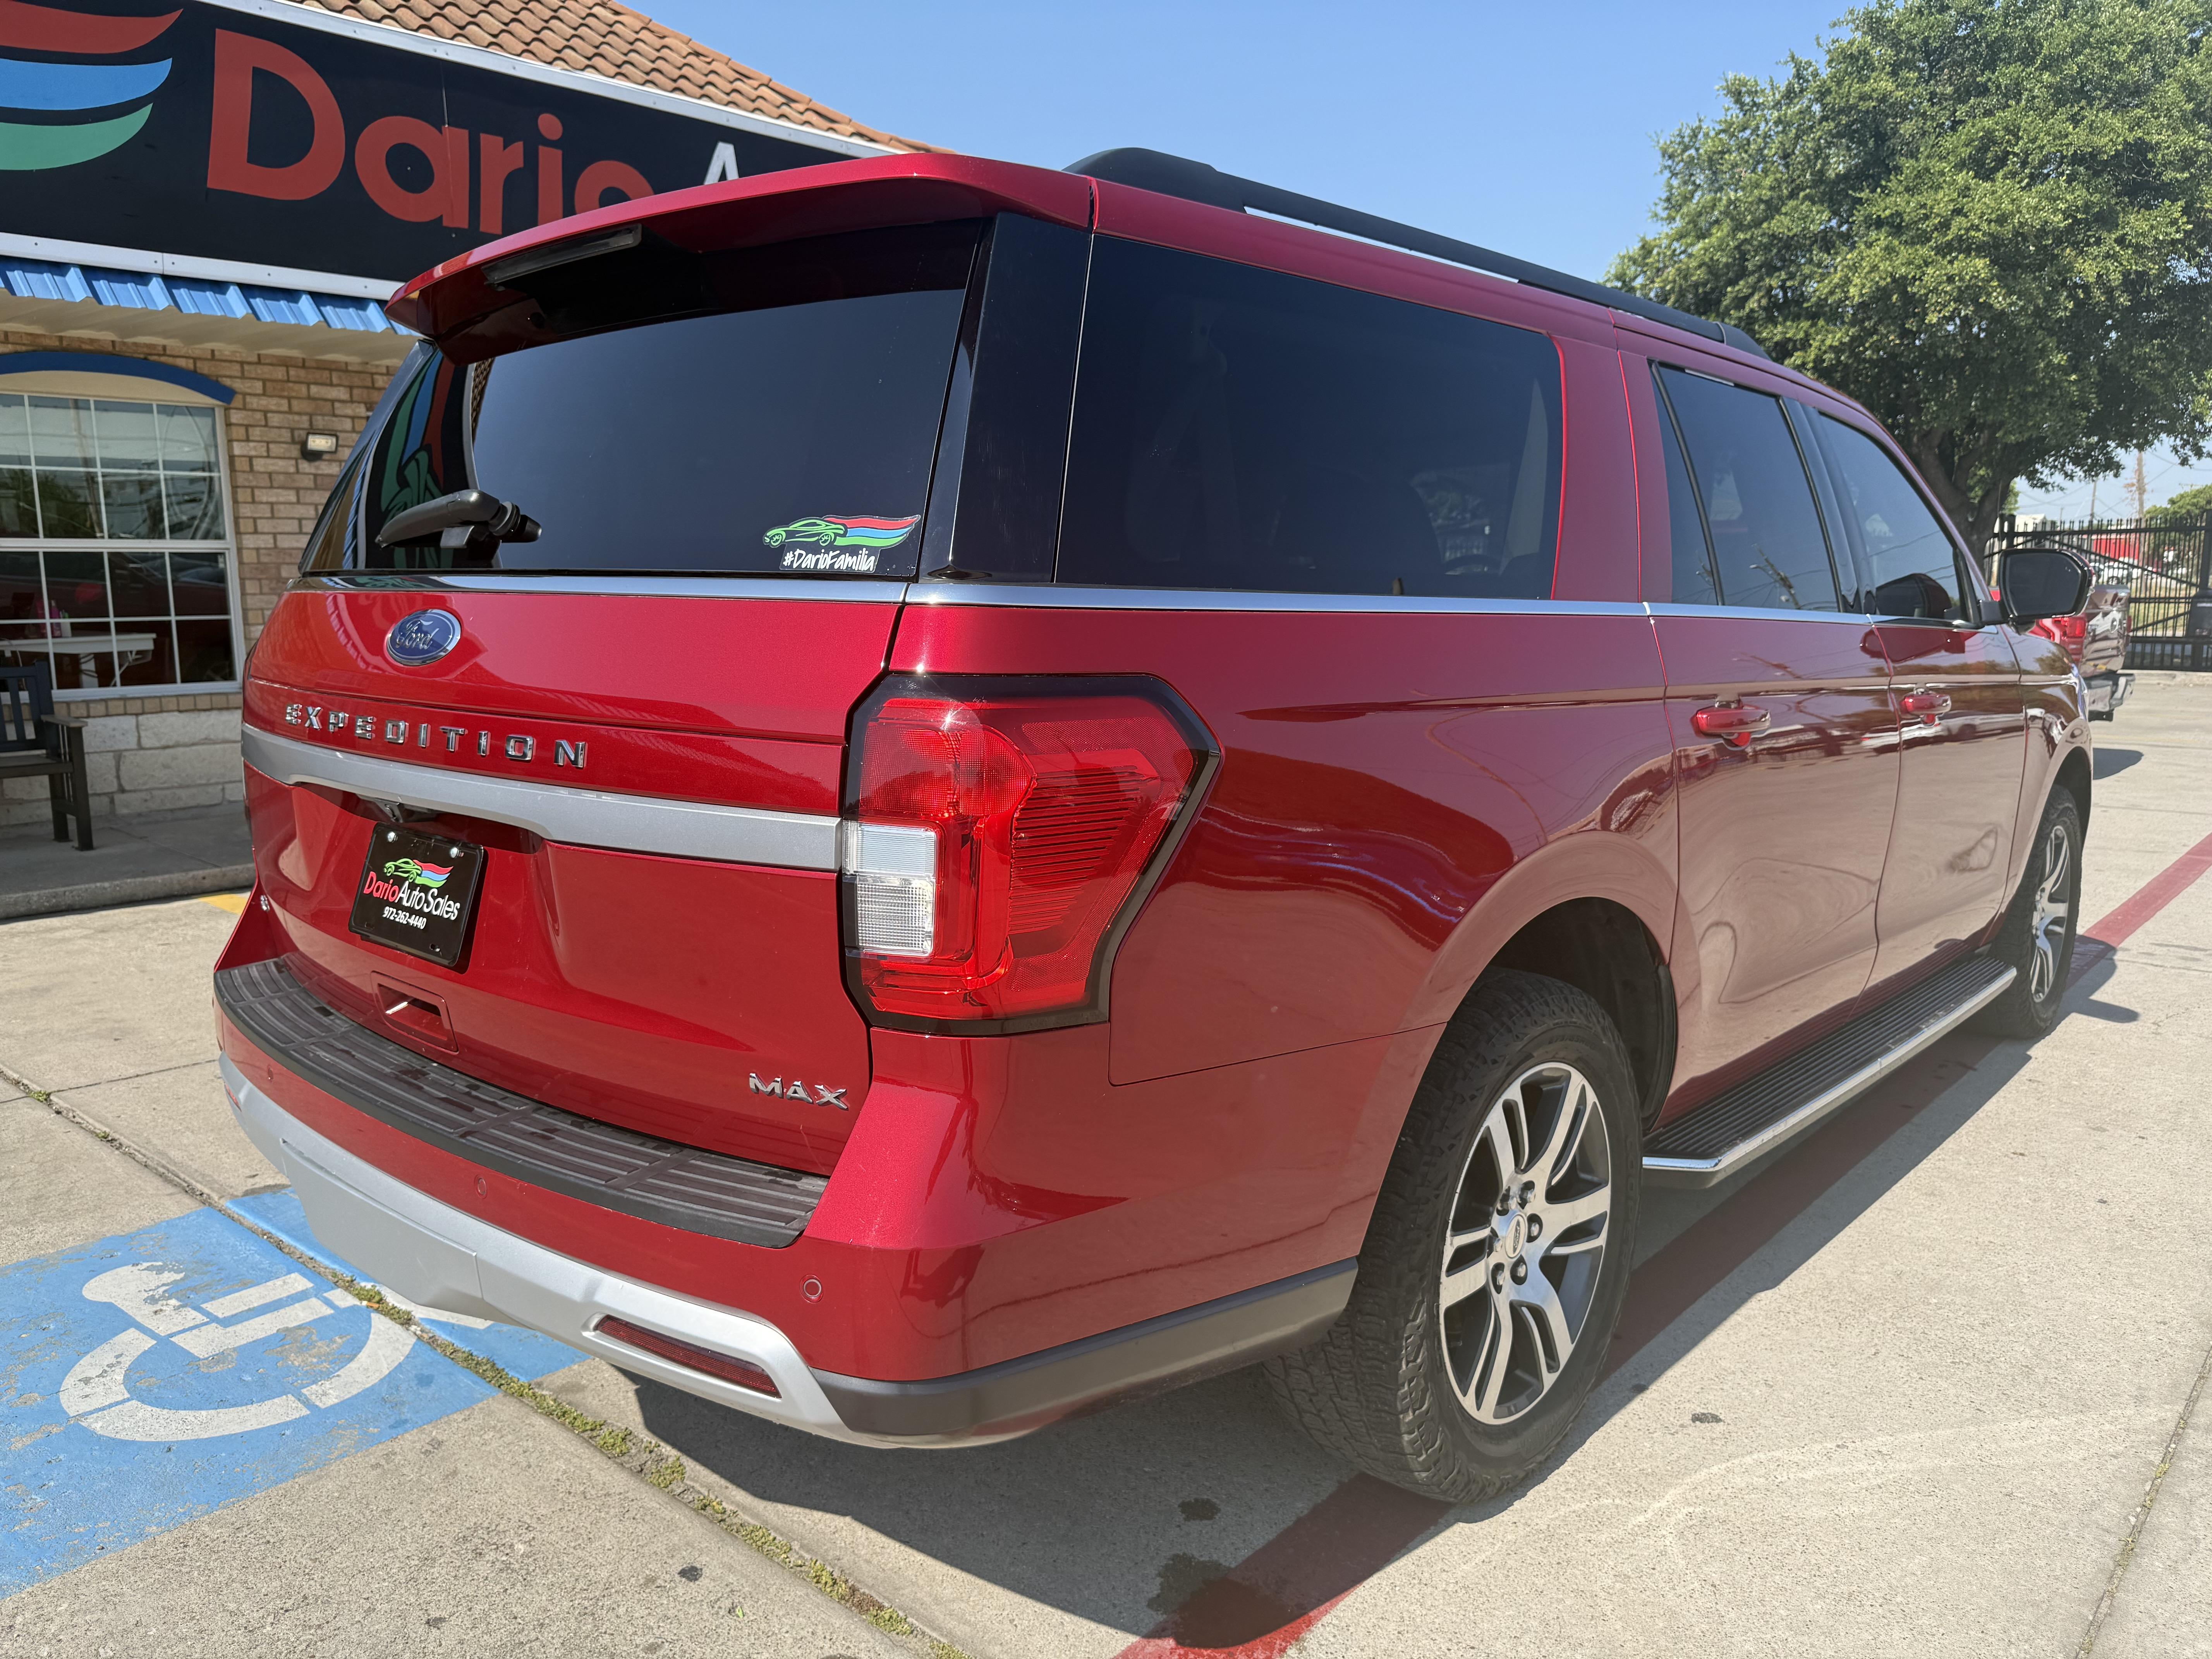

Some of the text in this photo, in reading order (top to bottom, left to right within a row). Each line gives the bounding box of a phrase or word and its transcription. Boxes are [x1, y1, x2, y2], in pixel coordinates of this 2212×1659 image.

[783, 548, 875, 571] #DarioFamilia
[396, 619, 439, 649] Ford
[285, 704, 587, 769] EXPEDITION
[383, 907, 427, 929] 972-262-4440
[424, 888, 460, 920] Sales
[749, 1073, 848, 1111] MAX
